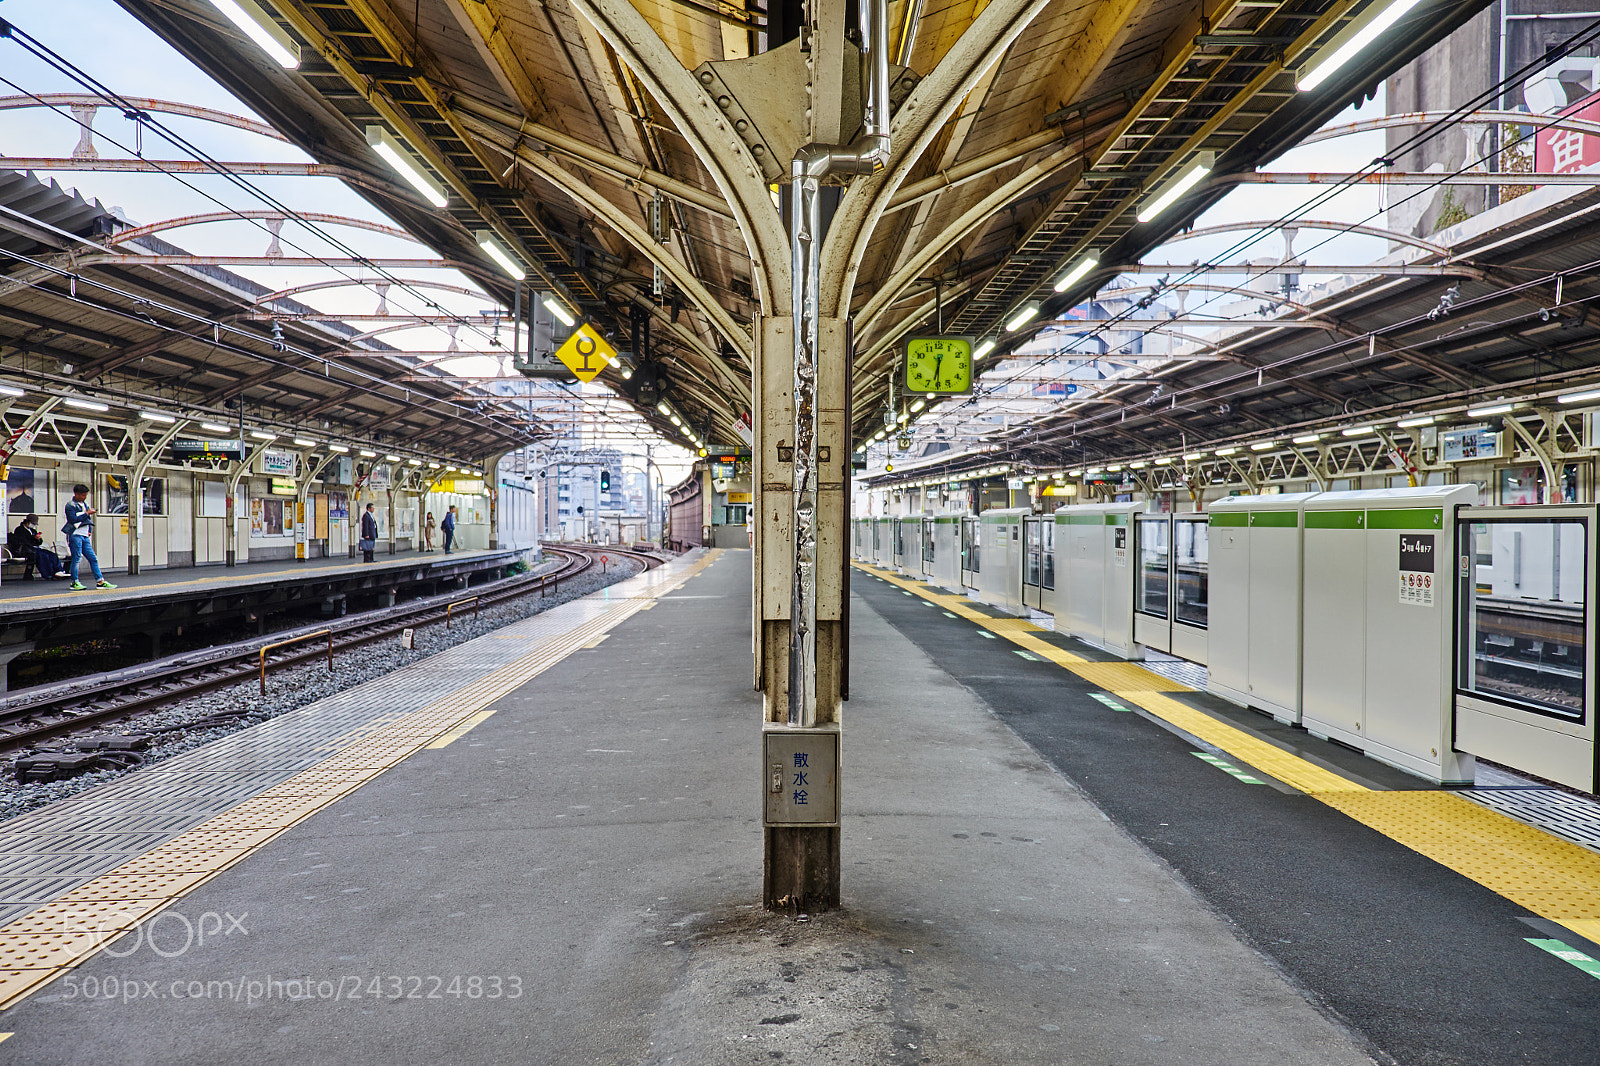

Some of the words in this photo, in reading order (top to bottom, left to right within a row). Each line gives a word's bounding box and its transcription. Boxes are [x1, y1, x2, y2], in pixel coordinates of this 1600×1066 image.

[232, 441, 238, 450] 4
[792, 752, 809, 805] 散水栓
